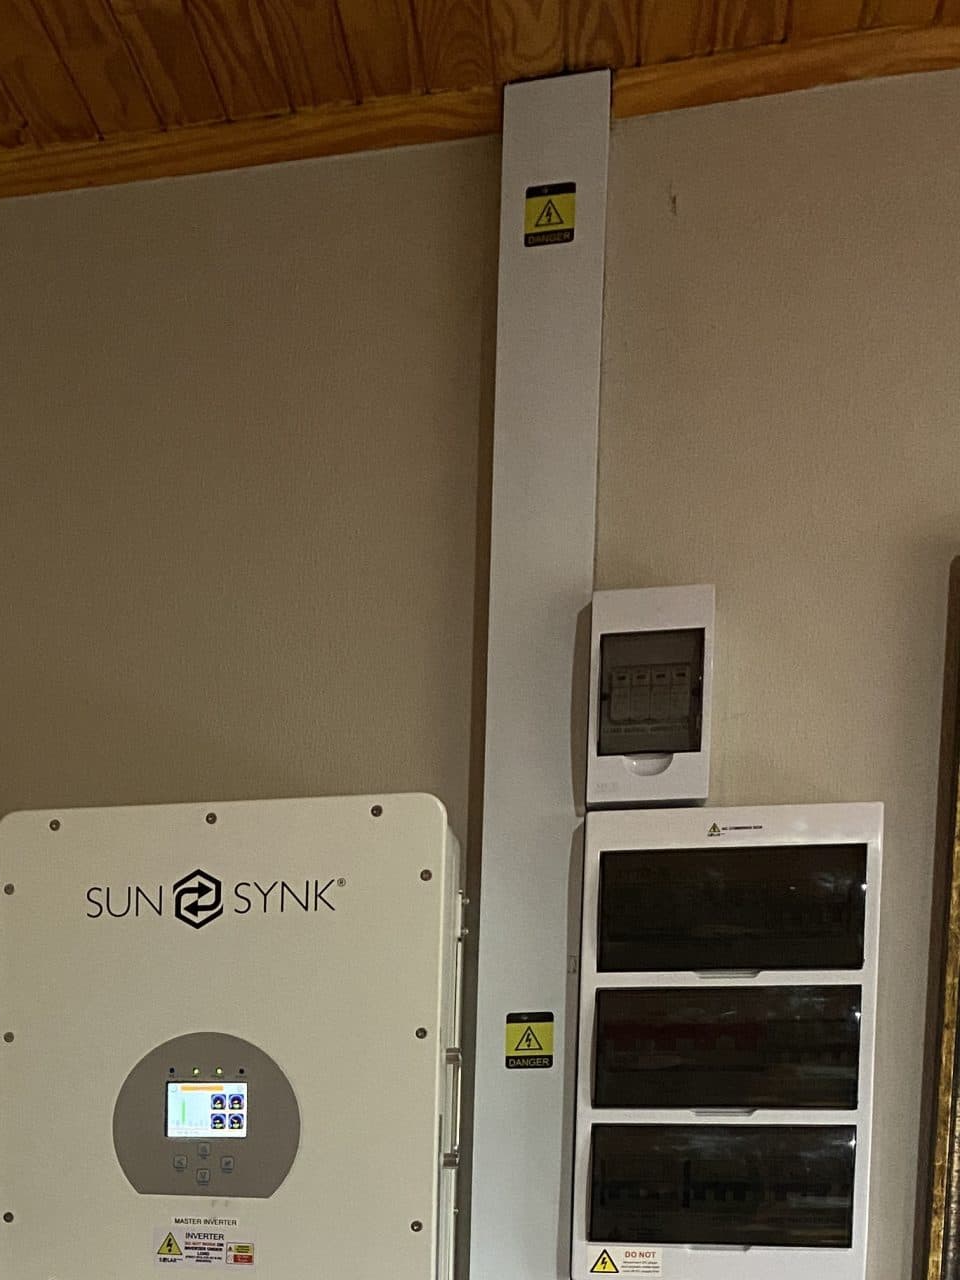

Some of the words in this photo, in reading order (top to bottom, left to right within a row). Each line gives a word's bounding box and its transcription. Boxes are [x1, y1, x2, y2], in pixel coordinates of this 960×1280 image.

[86, 886, 163, 918] SUN
[508, 1057, 550, 1067] DANGER
[185, 1232, 224, 1240] INVERTER
